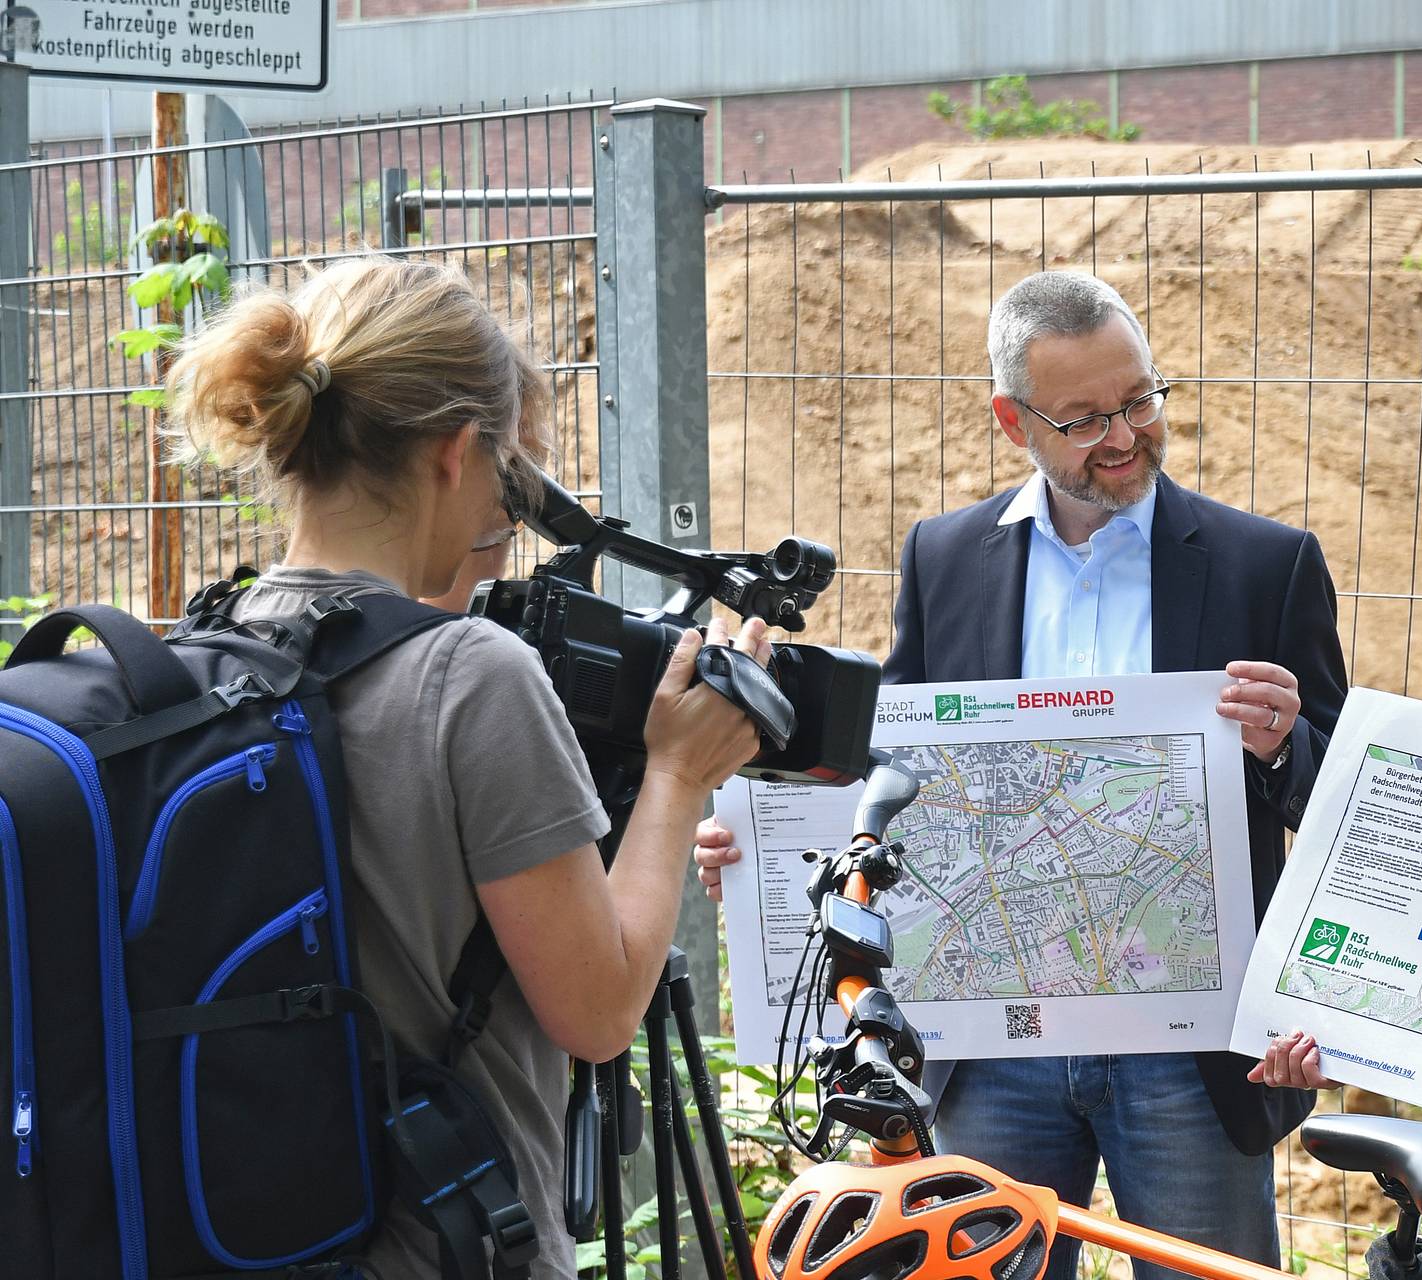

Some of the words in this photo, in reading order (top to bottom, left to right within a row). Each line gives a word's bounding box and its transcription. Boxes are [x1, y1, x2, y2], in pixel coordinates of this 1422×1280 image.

[191, 0, 290, 16] abgestellte
[84, 10, 177, 39] Fahrzeuge
[188, 19, 254, 39] werden
[36, 37, 172, 67] kostenpflichtig
[182, 44, 302, 74] abgeschleppt
[963, 701, 1015, 711] Radschnellweg
[1017, 690, 1114, 709] BERNARD
[877, 701, 915, 712] STADT
[1072, 708, 1115, 718] GRUPPE
[877, 712, 933, 723] BOCHUM
[964, 711, 981, 719] Ruhr
[1370, 786, 1382, 796] der
[1383, 789, 1422, 808] Innenstadt
[1350, 932, 1370, 945] RS1
[1341, 955, 1365, 969] Ruhr
[1345, 943, 1418, 974] Radschnellweg
[1169, 1021, 1188, 1031] Seite
[1189, 1021, 1195, 1030] 7
